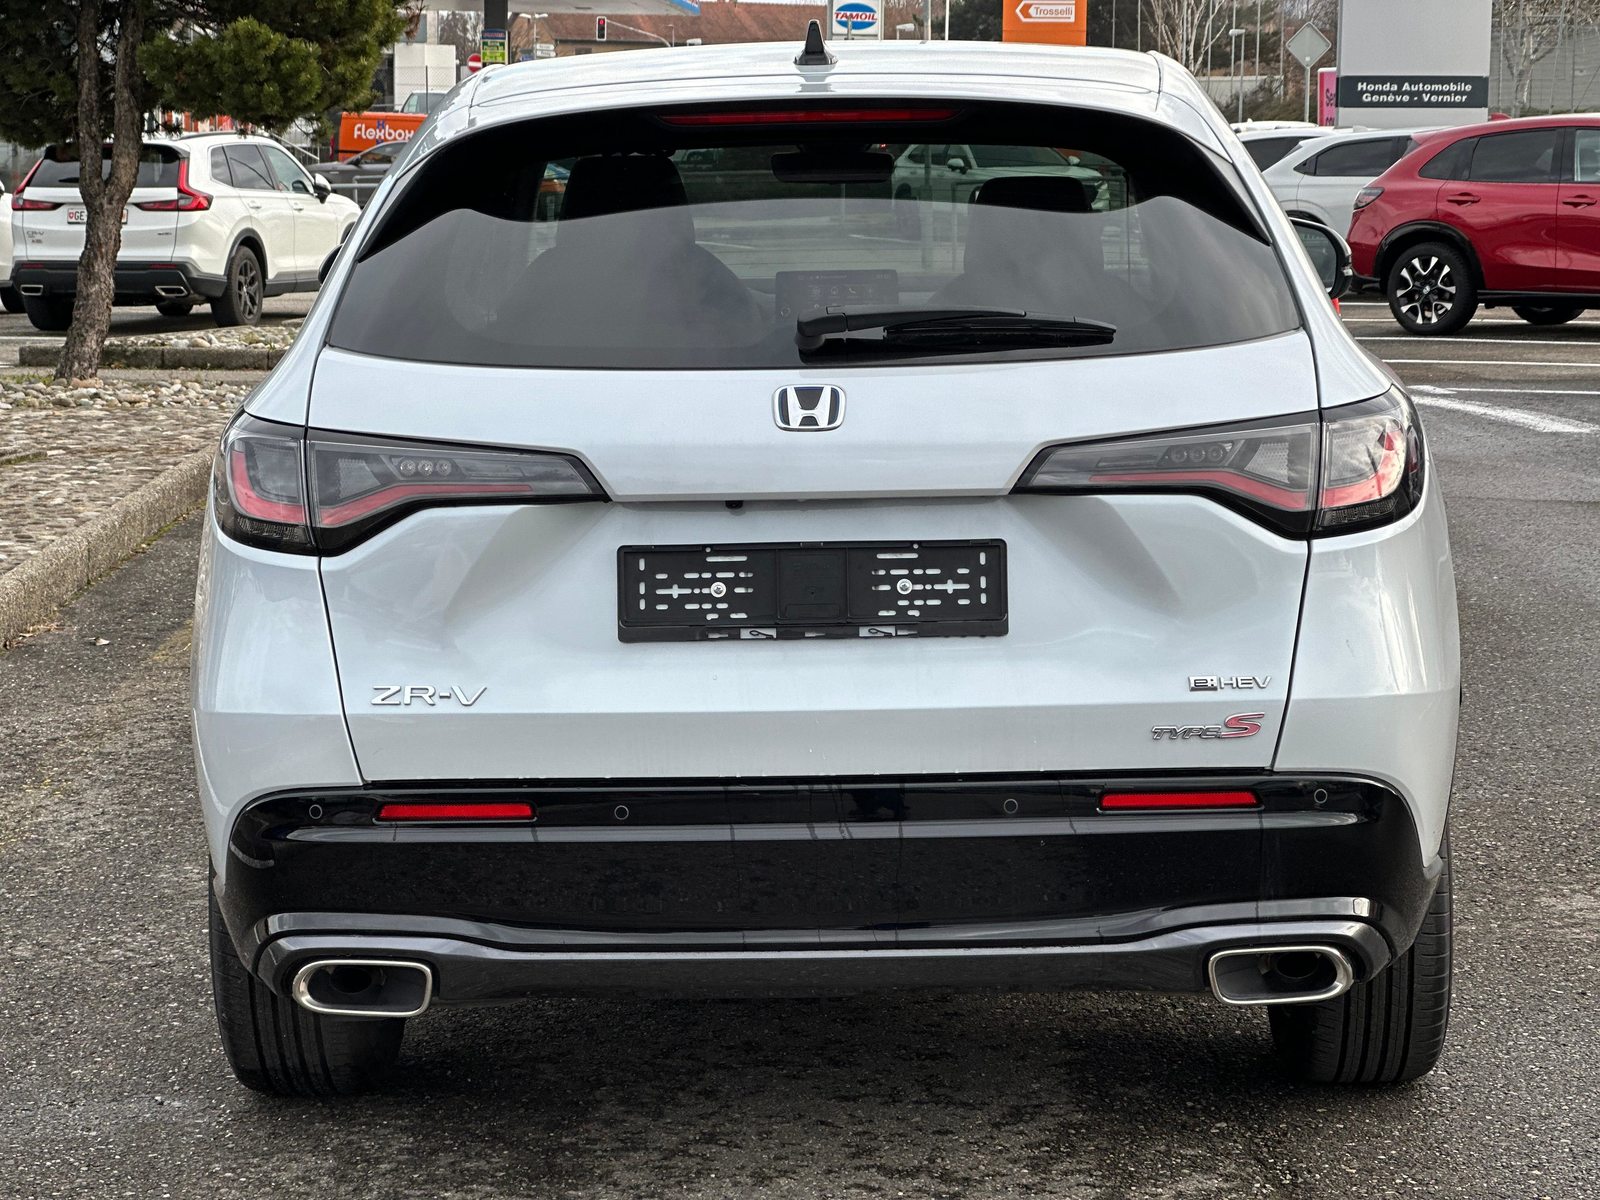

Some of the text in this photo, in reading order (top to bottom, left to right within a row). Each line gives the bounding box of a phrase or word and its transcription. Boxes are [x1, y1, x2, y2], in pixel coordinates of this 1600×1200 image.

[1034, 6, 1073, 16] Trosselli
[834, 12, 878, 21] TAMOIL
[1357, 82, 1472, 92] Honda Automobile
[1362, 92, 1410, 103] Genève
[1422, 93, 1468, 103] Vernier
[371, 685, 488, 707] ZR-V
